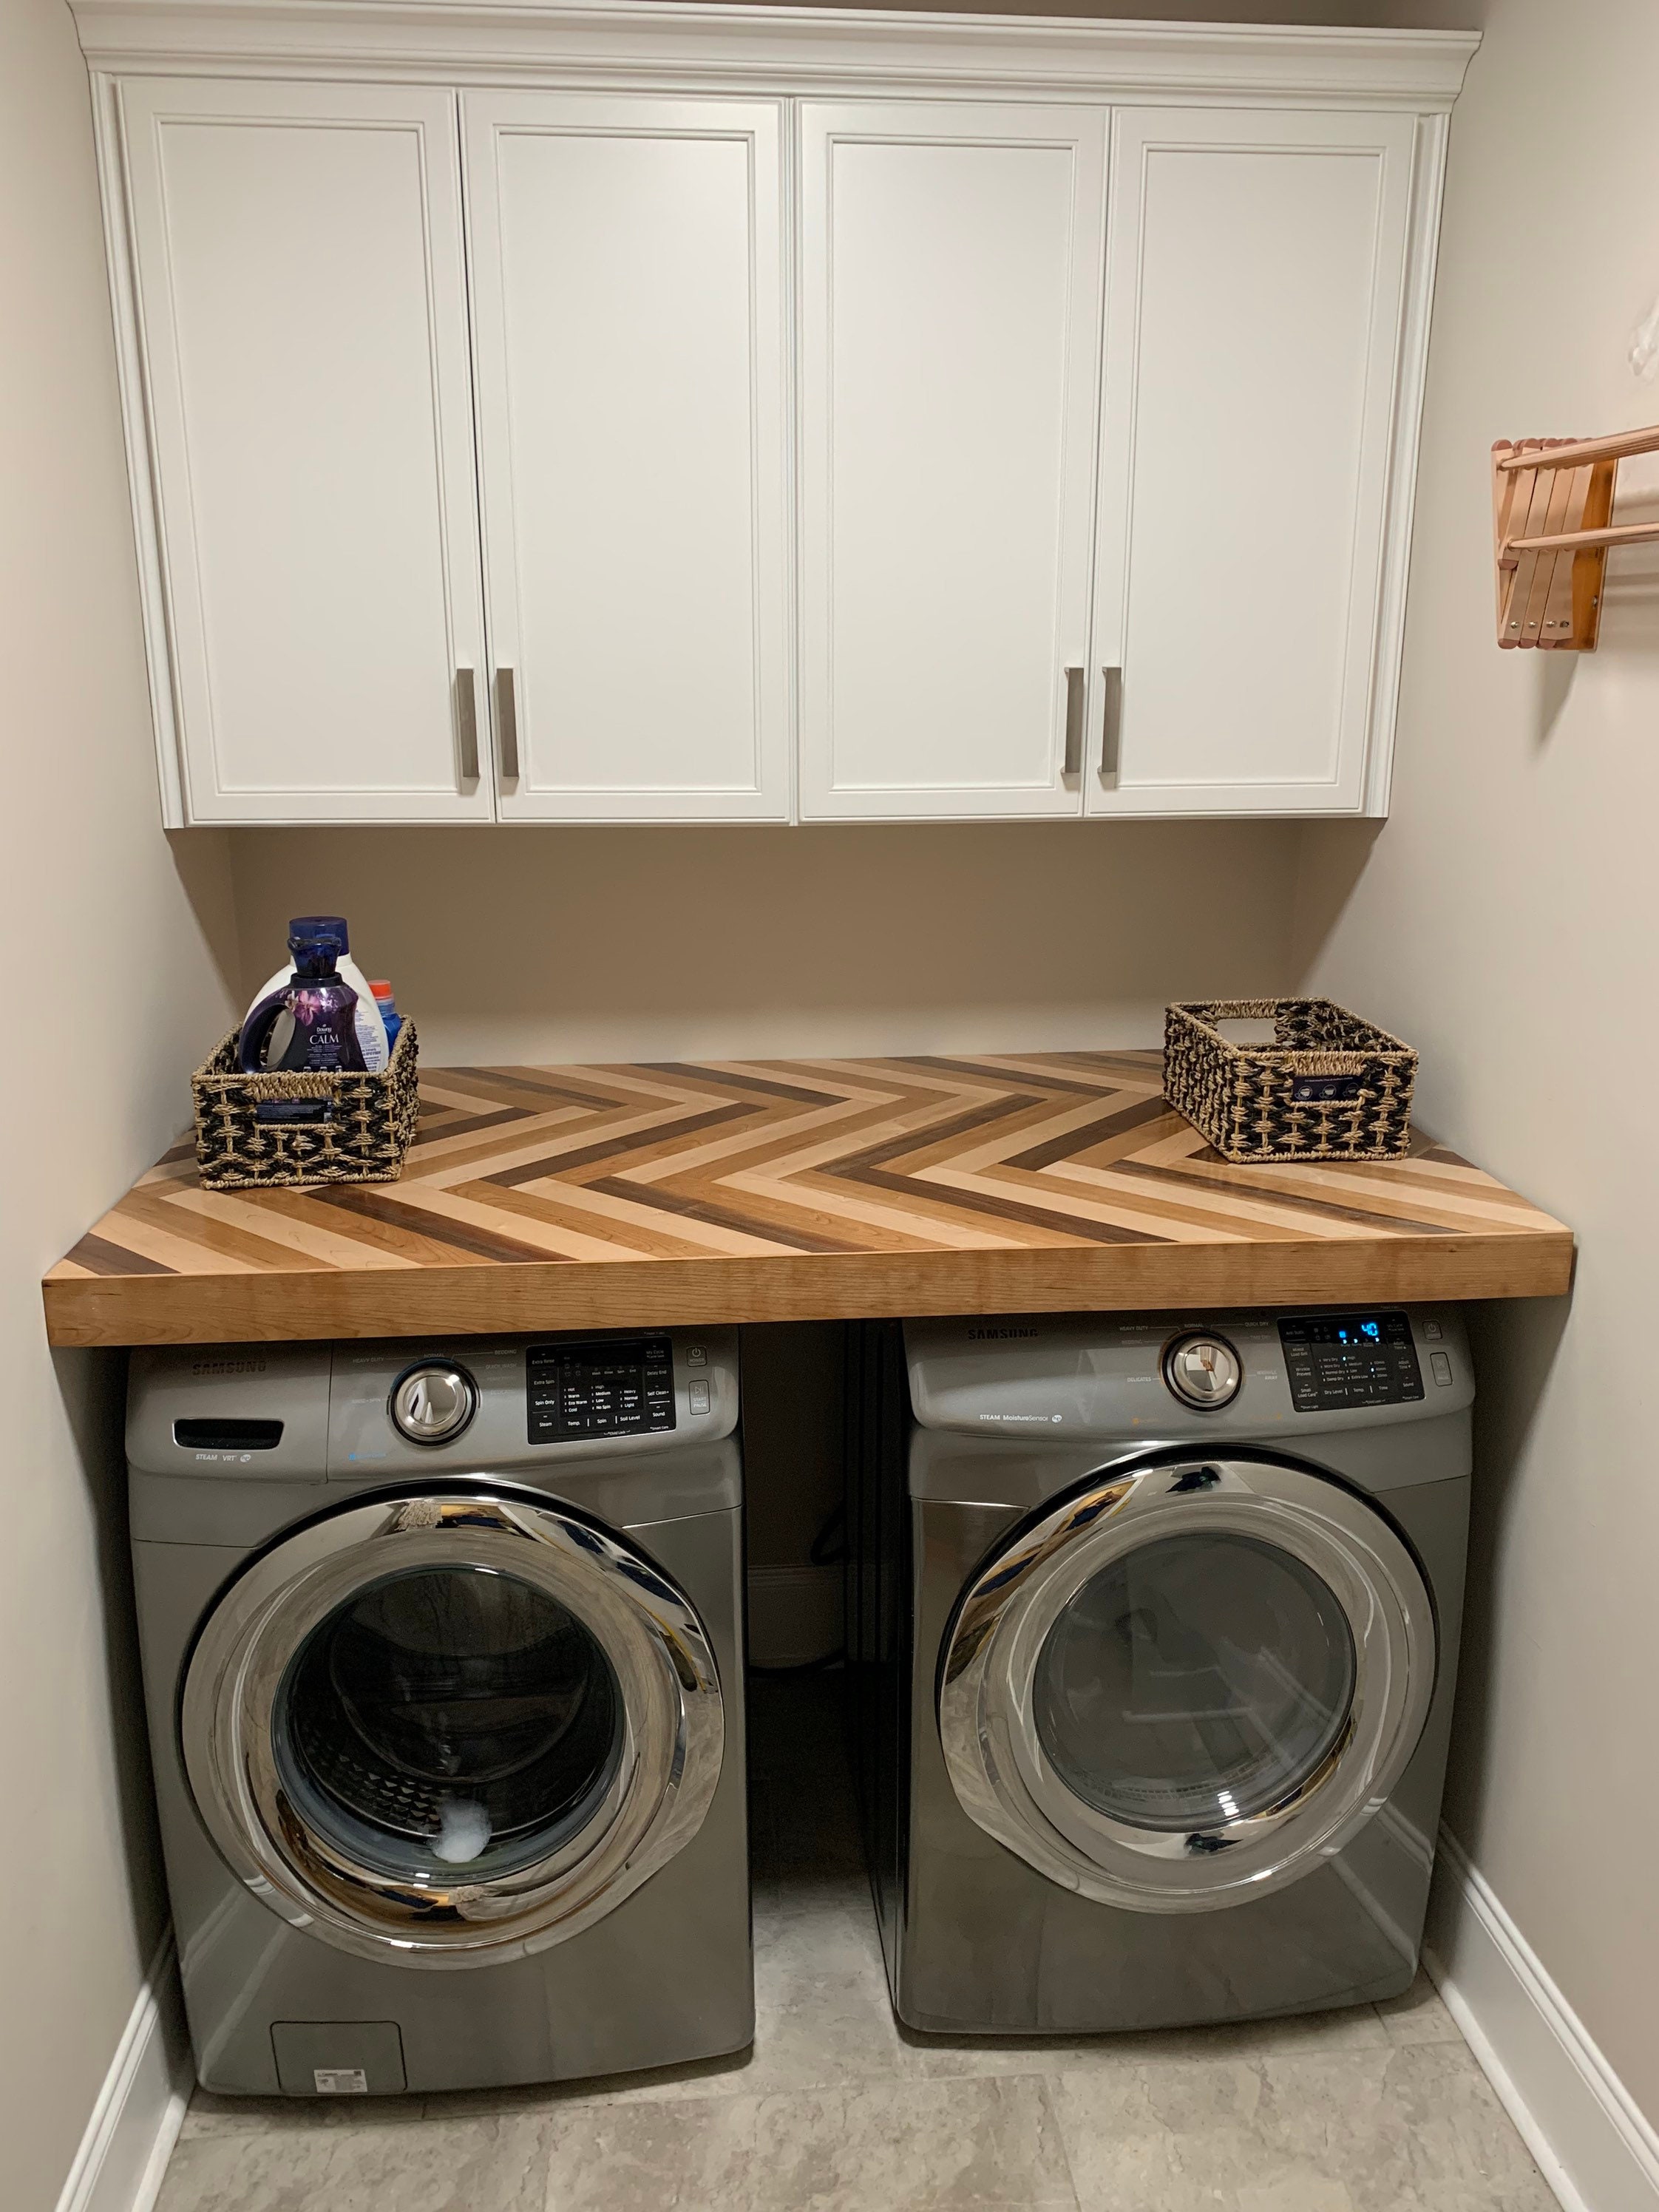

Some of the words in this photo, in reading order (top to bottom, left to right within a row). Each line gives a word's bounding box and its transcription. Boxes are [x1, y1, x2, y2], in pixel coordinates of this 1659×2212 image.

[309, 1034, 339, 1045] CALM
[968, 1329, 1039, 1340] SAMSUNG
[1361, 1322, 1379, 1336] 40
[192, 1361, 267, 1375] SAMSUNG
